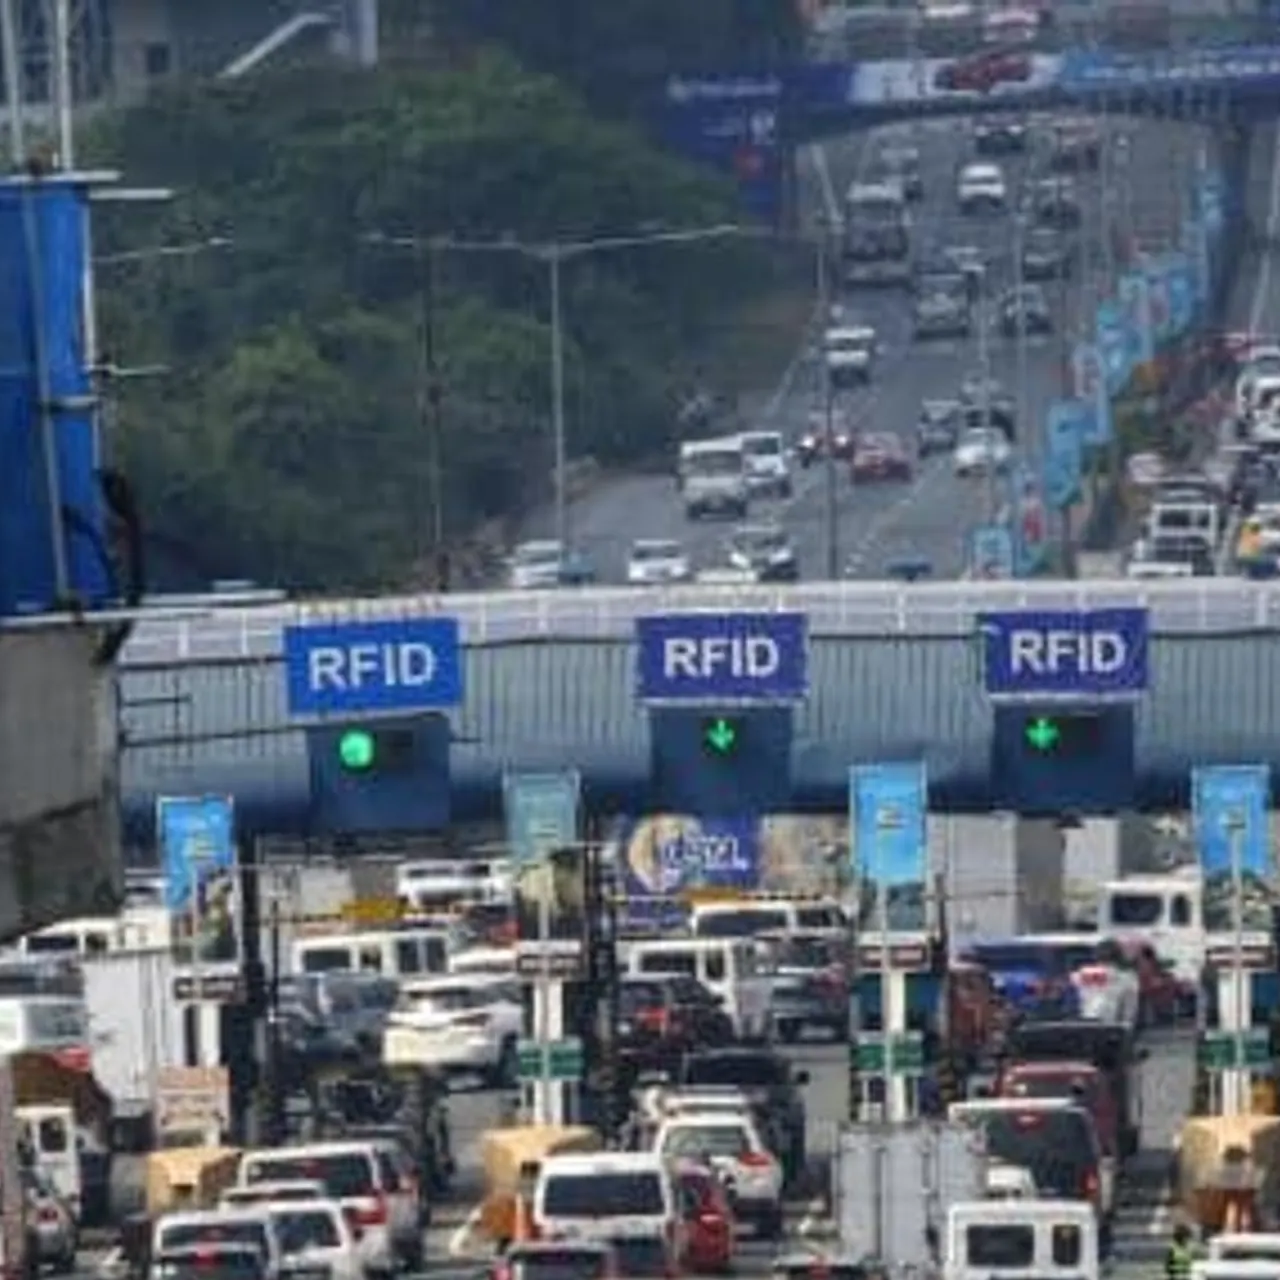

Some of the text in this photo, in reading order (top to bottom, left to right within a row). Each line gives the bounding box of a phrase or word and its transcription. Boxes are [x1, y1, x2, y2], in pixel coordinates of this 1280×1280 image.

[308, 642, 436, 691] RFID
[664, 637, 779, 678] RFID
[1011, 629, 1125, 674] RFID
